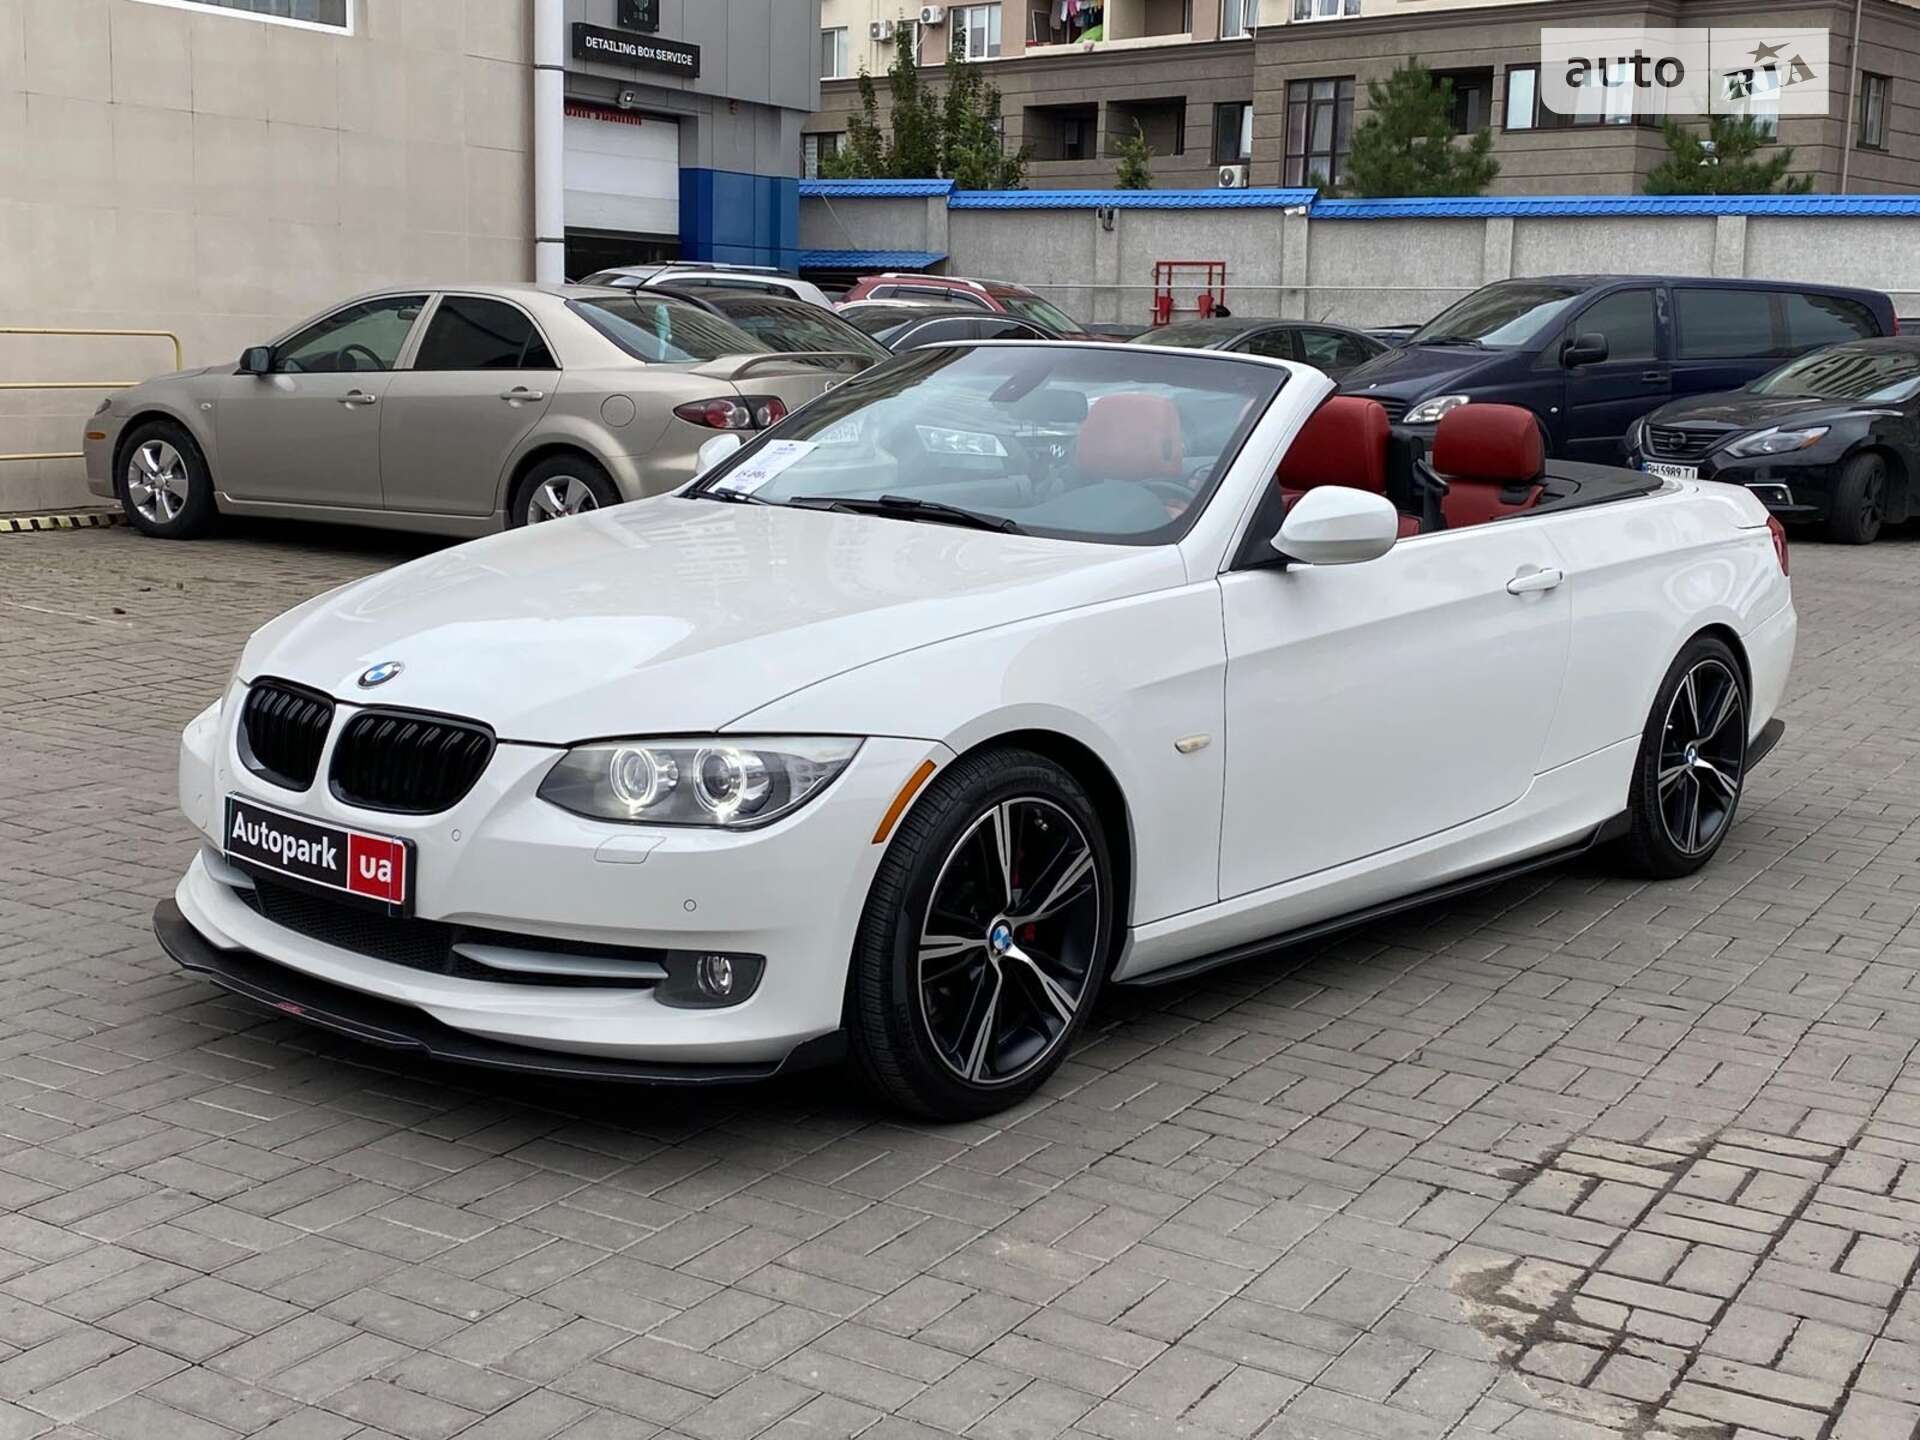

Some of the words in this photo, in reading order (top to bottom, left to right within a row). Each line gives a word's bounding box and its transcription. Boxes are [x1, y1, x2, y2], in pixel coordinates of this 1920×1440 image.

[585, 36, 637, 55] DETAILING
[637, 46, 655, 59] BOX
[655, 49, 693, 66] SERVICE
[231, 811, 337, 870] Autopark
[359, 854, 392, 883] ua
